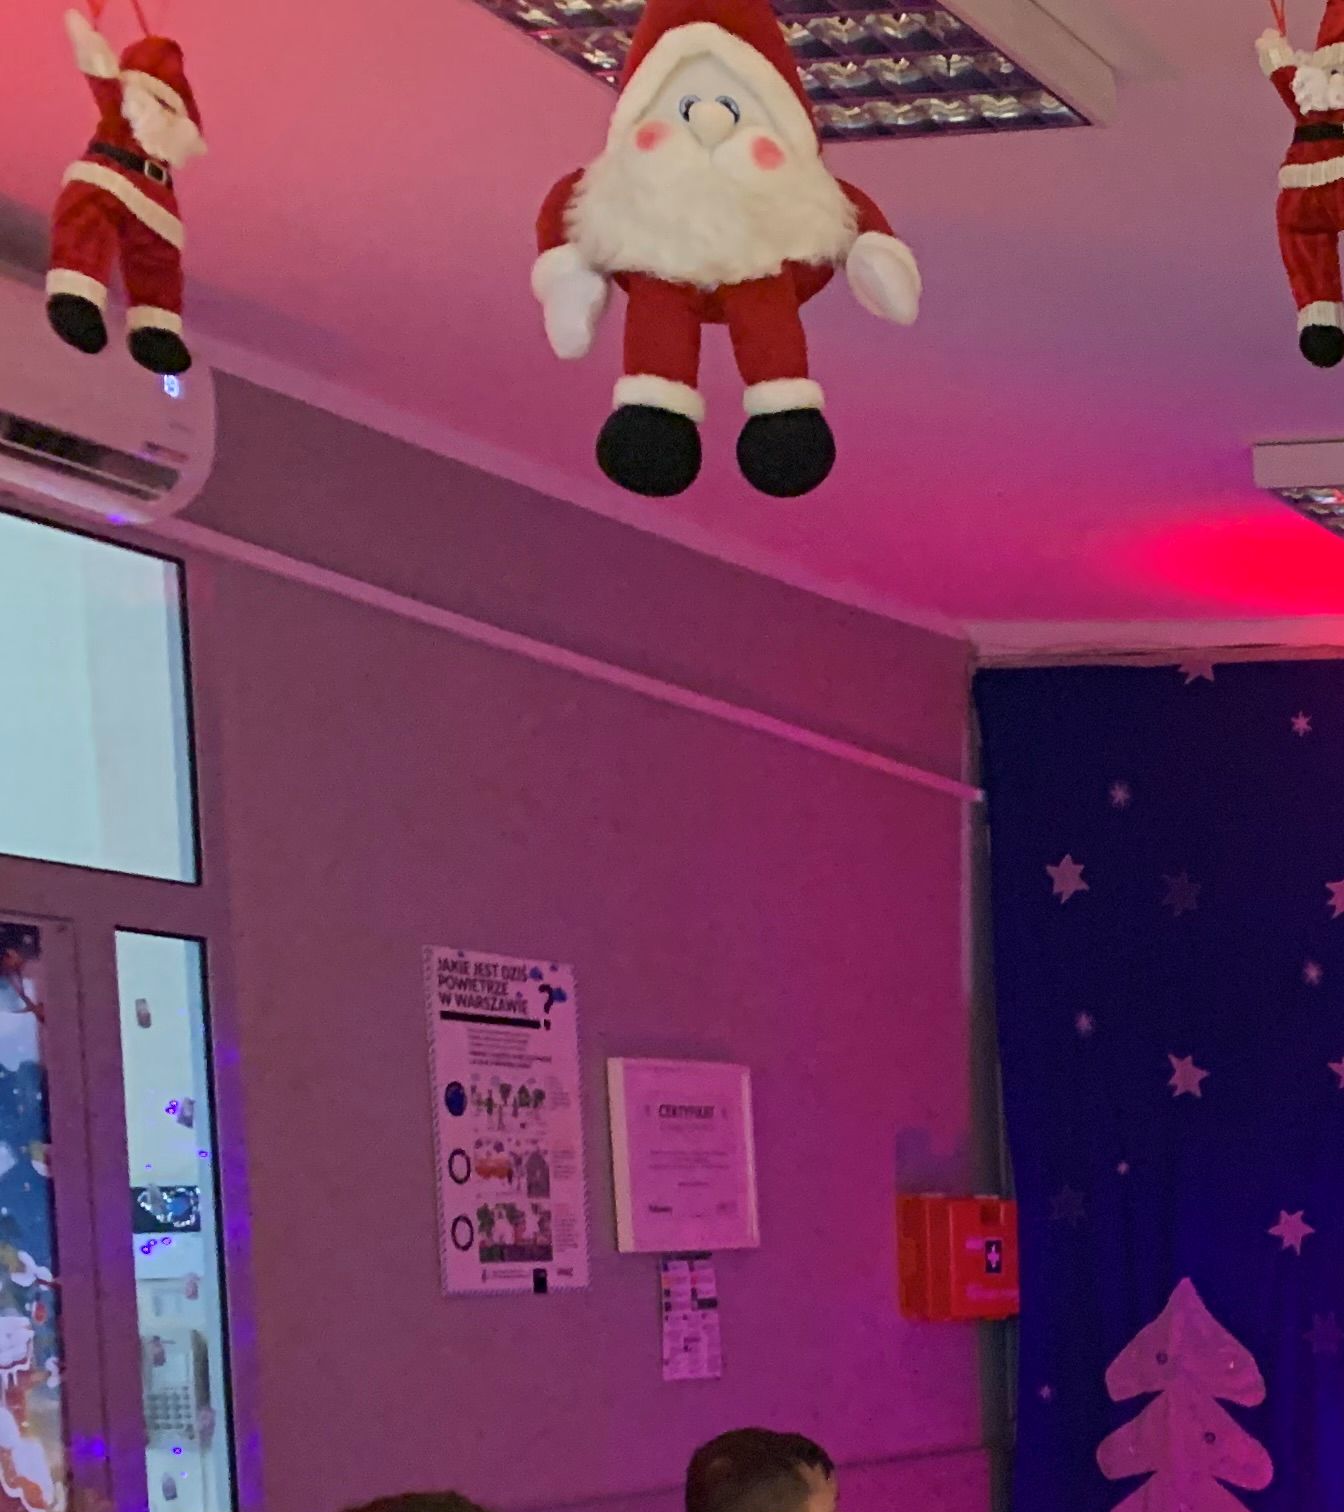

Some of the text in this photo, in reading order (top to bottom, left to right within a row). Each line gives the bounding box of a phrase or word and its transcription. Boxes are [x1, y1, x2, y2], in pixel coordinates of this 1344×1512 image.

[438, 958, 469, 975] JAKIE
[474, 962, 499, 977] JEST
[438, 974, 509, 996] POWIETRZE
[439, 992, 452, 1006] W
[455, 994, 528, 1015] WARSZAWIE
